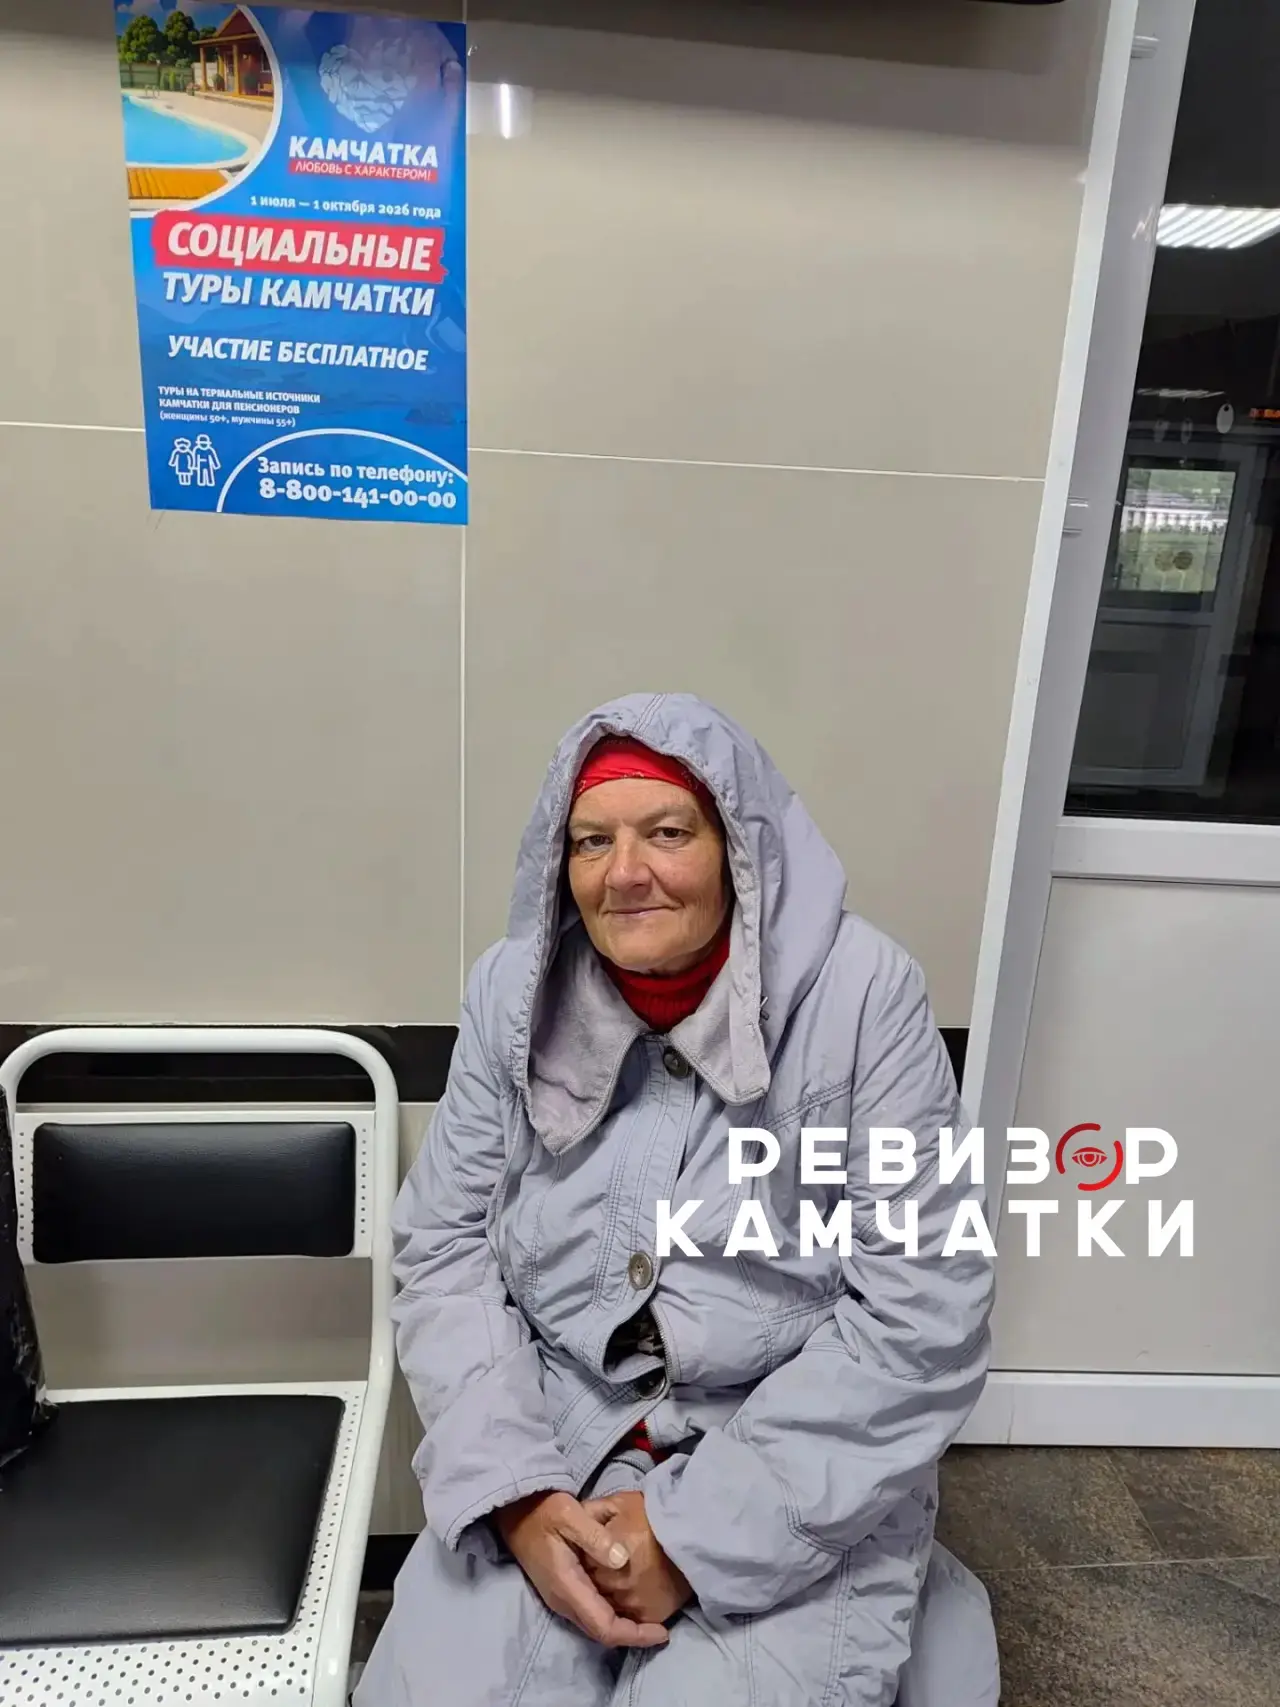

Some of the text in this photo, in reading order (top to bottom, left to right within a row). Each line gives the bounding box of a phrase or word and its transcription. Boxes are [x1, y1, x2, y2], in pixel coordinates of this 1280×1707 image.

[289, 136, 438, 167] КАМЧАТКА
[295, 161, 431, 181] ЛЮБОВЬ С ХАРАКТЕРОМ!
[250, 196, 257, 206] 1
[260, 197, 296, 208] июля
[313, 200, 319, 210] 1
[322, 199, 375, 216] октября
[378, 203, 409, 216] 2026
[412, 207, 441, 220] года
[168, 221, 435, 272] СОЦИАЛЬНЫЕ
[163, 272, 435, 316] ТУРЫ КАМЧАТКИ
[168, 335, 428, 371] УЧАСТИЕ БЕСПЛАТНОЕ
[158, 386, 320, 403] ТУРЫ НА ТЕРМАЛЬНЫЕ ИСТОЧНИКИ
[159, 399, 300, 414] КАМЧАТКИ ДЛЯ ПЕНСИОНЕРОВ
[160, 410, 296, 427] (женщины 50+, мужчины 55+)
[258, 456, 454, 487] Запись по телефону:
[259, 478, 457, 509] 8-800-141-00-00
